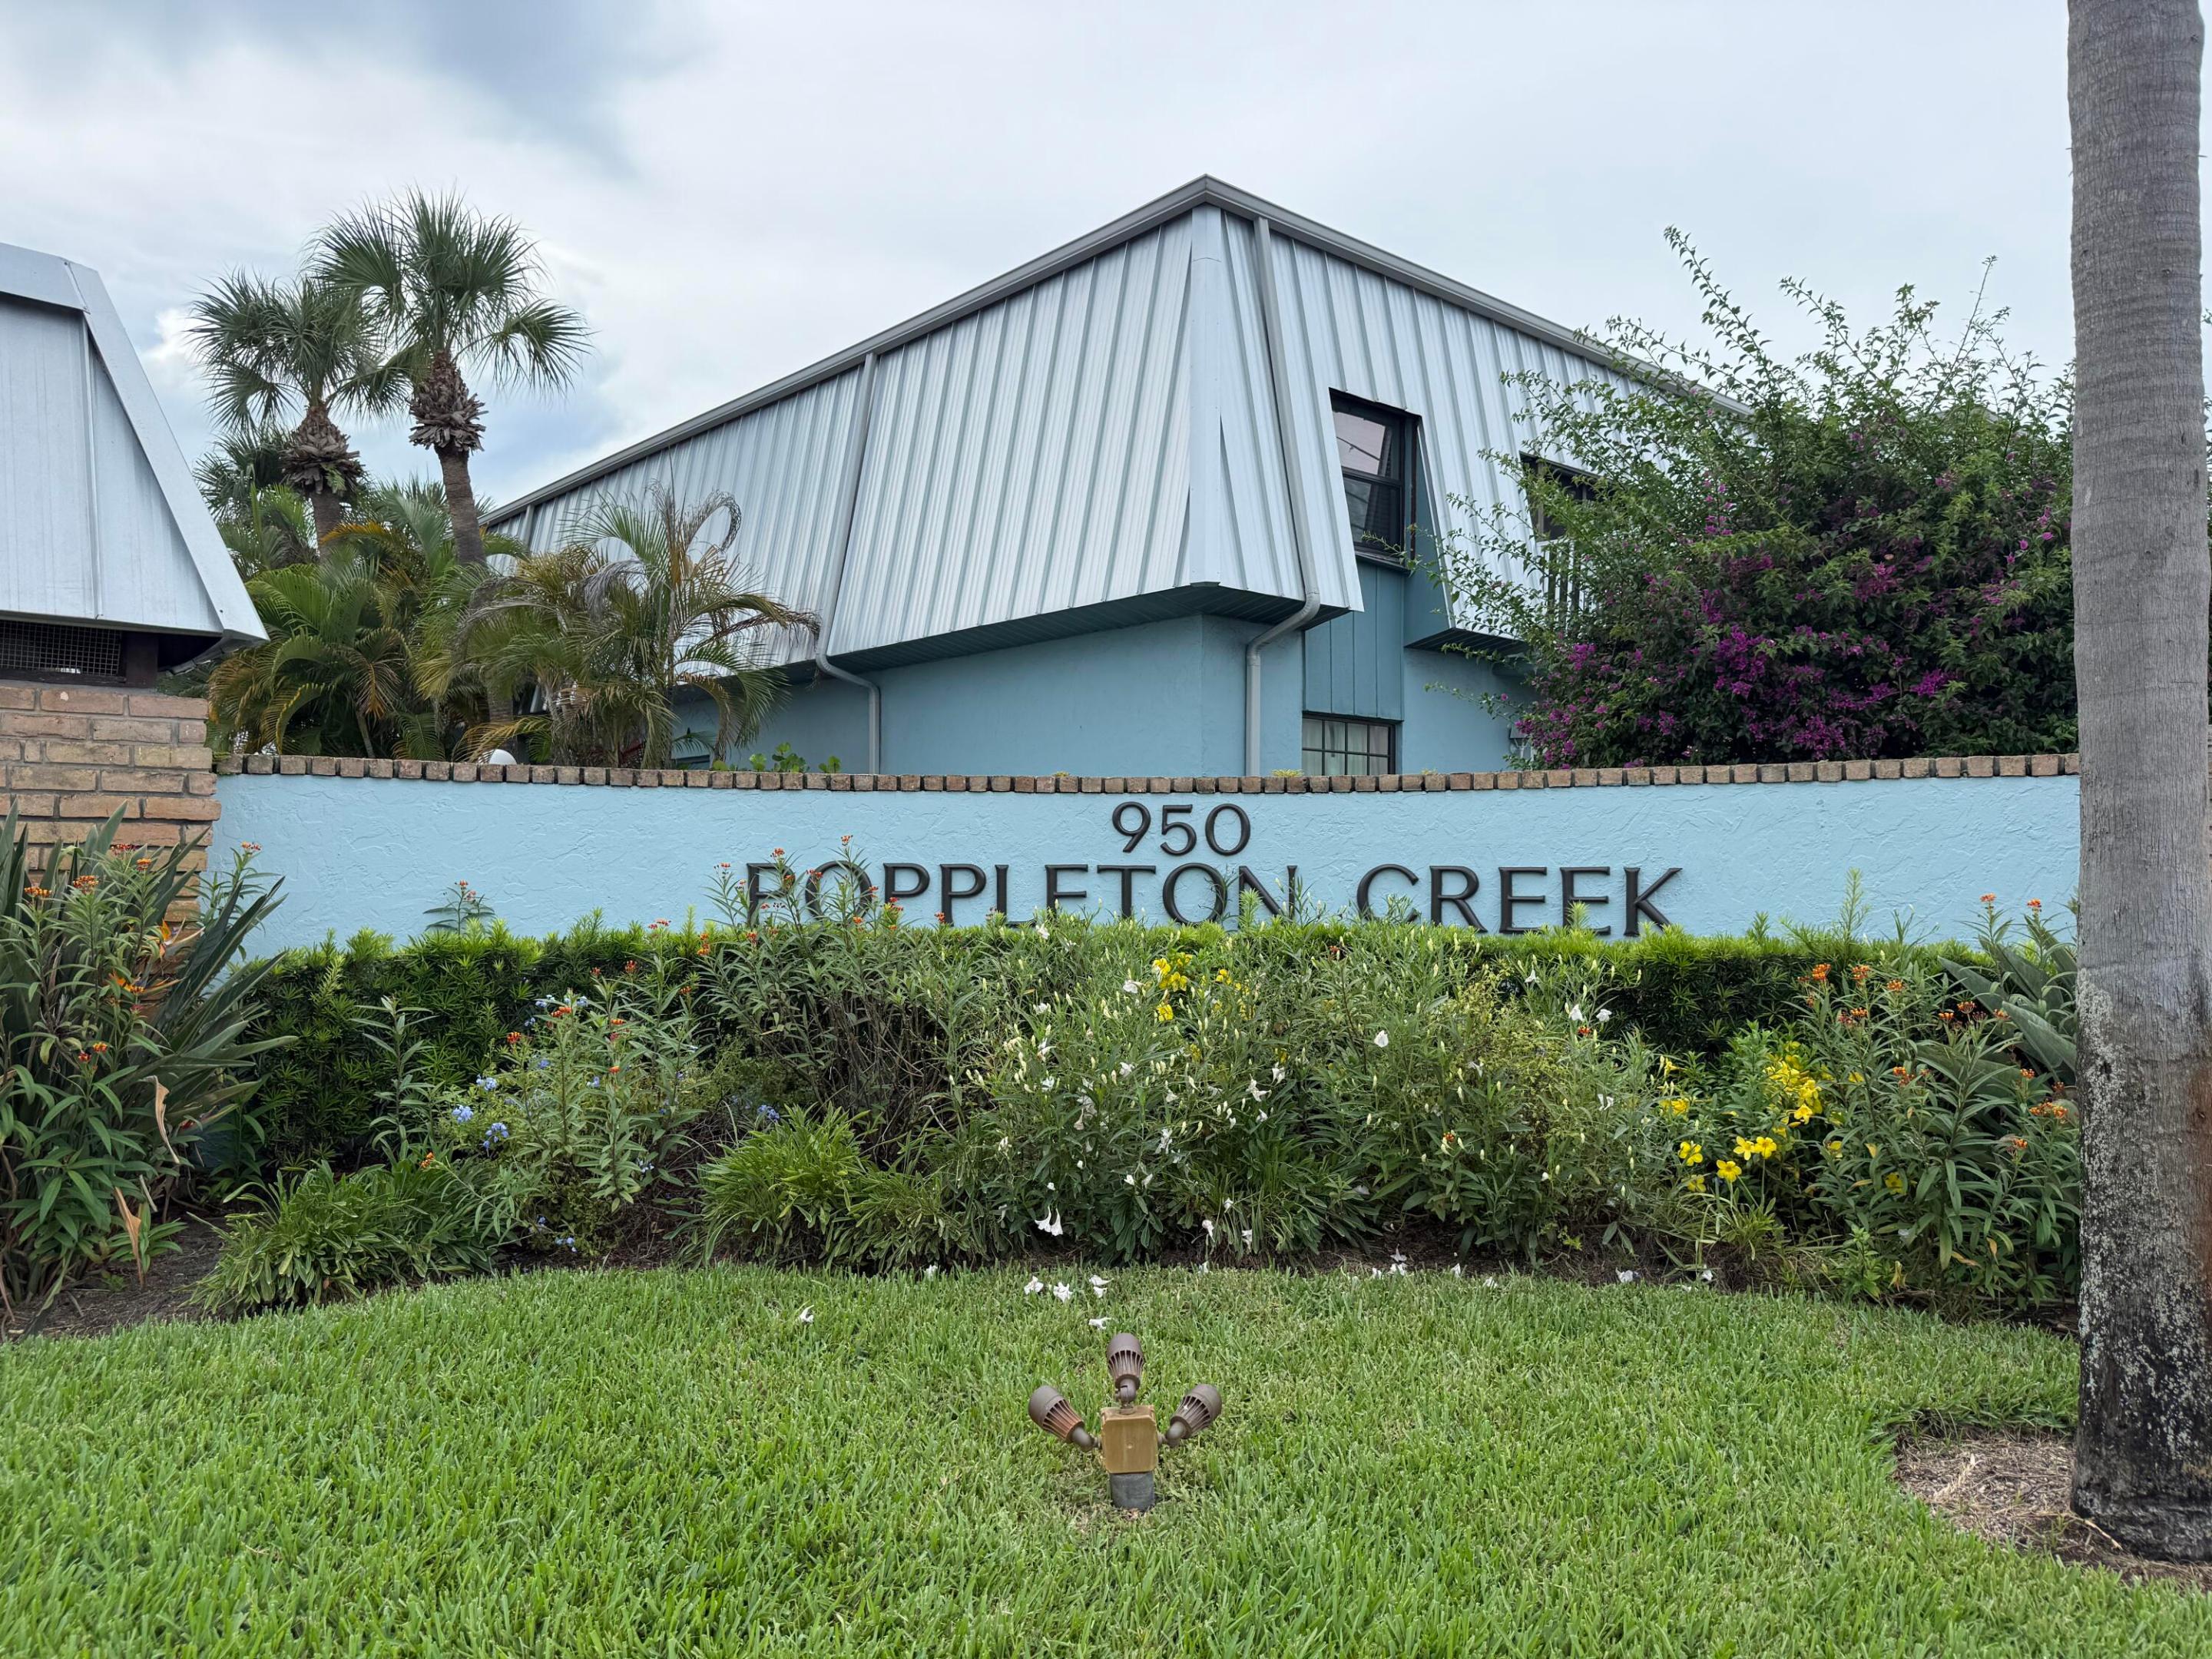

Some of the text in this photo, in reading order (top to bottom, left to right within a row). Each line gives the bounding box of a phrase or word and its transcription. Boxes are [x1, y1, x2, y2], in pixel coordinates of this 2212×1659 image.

[1111, 801, 1251, 856] 950
[746, 861, 1684, 937] POPPLETON CREEK
